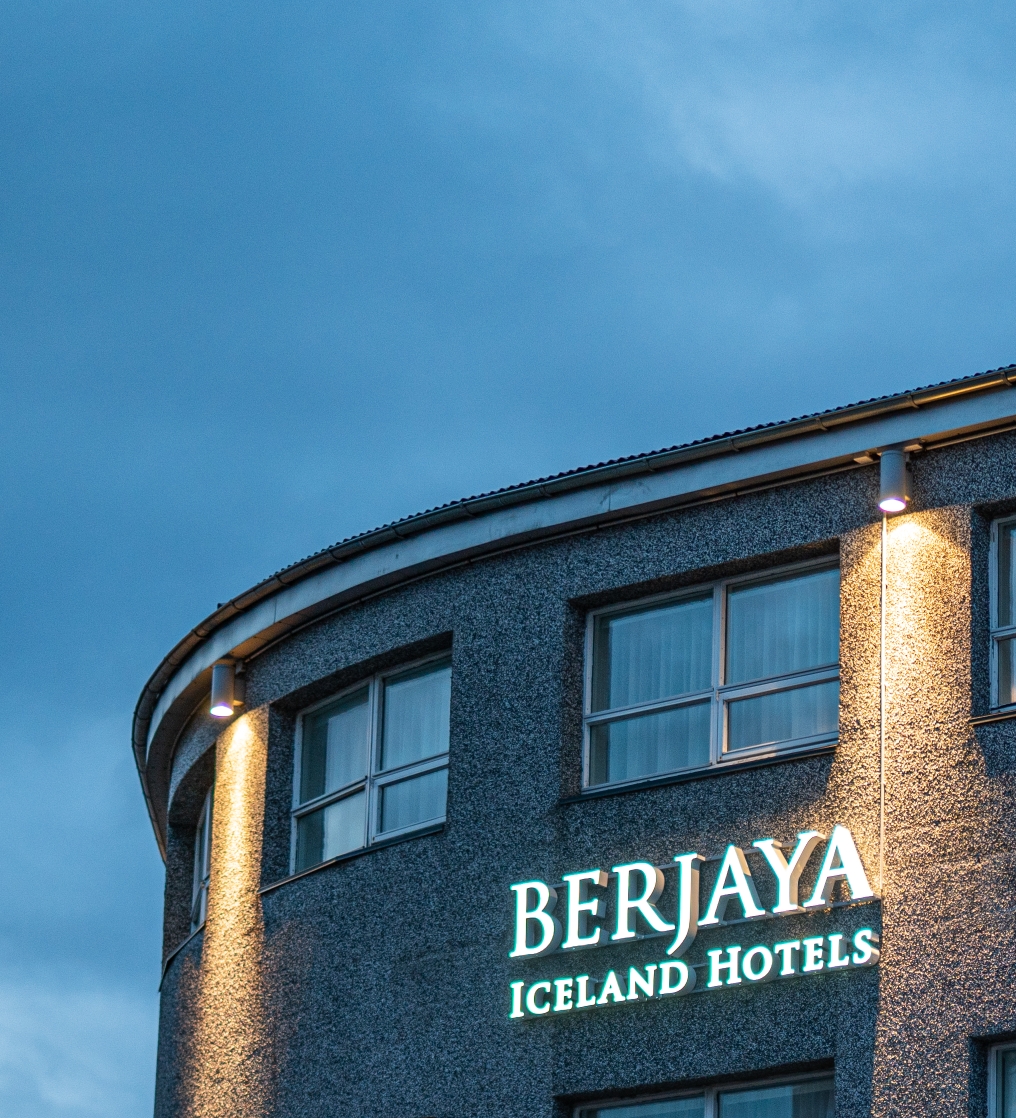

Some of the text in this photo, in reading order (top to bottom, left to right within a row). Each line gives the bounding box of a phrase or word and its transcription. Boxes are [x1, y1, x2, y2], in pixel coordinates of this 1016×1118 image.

[508, 824, 876, 959] BERJAYA
[508, 929, 877, 1019] ICELAND HOTELS
